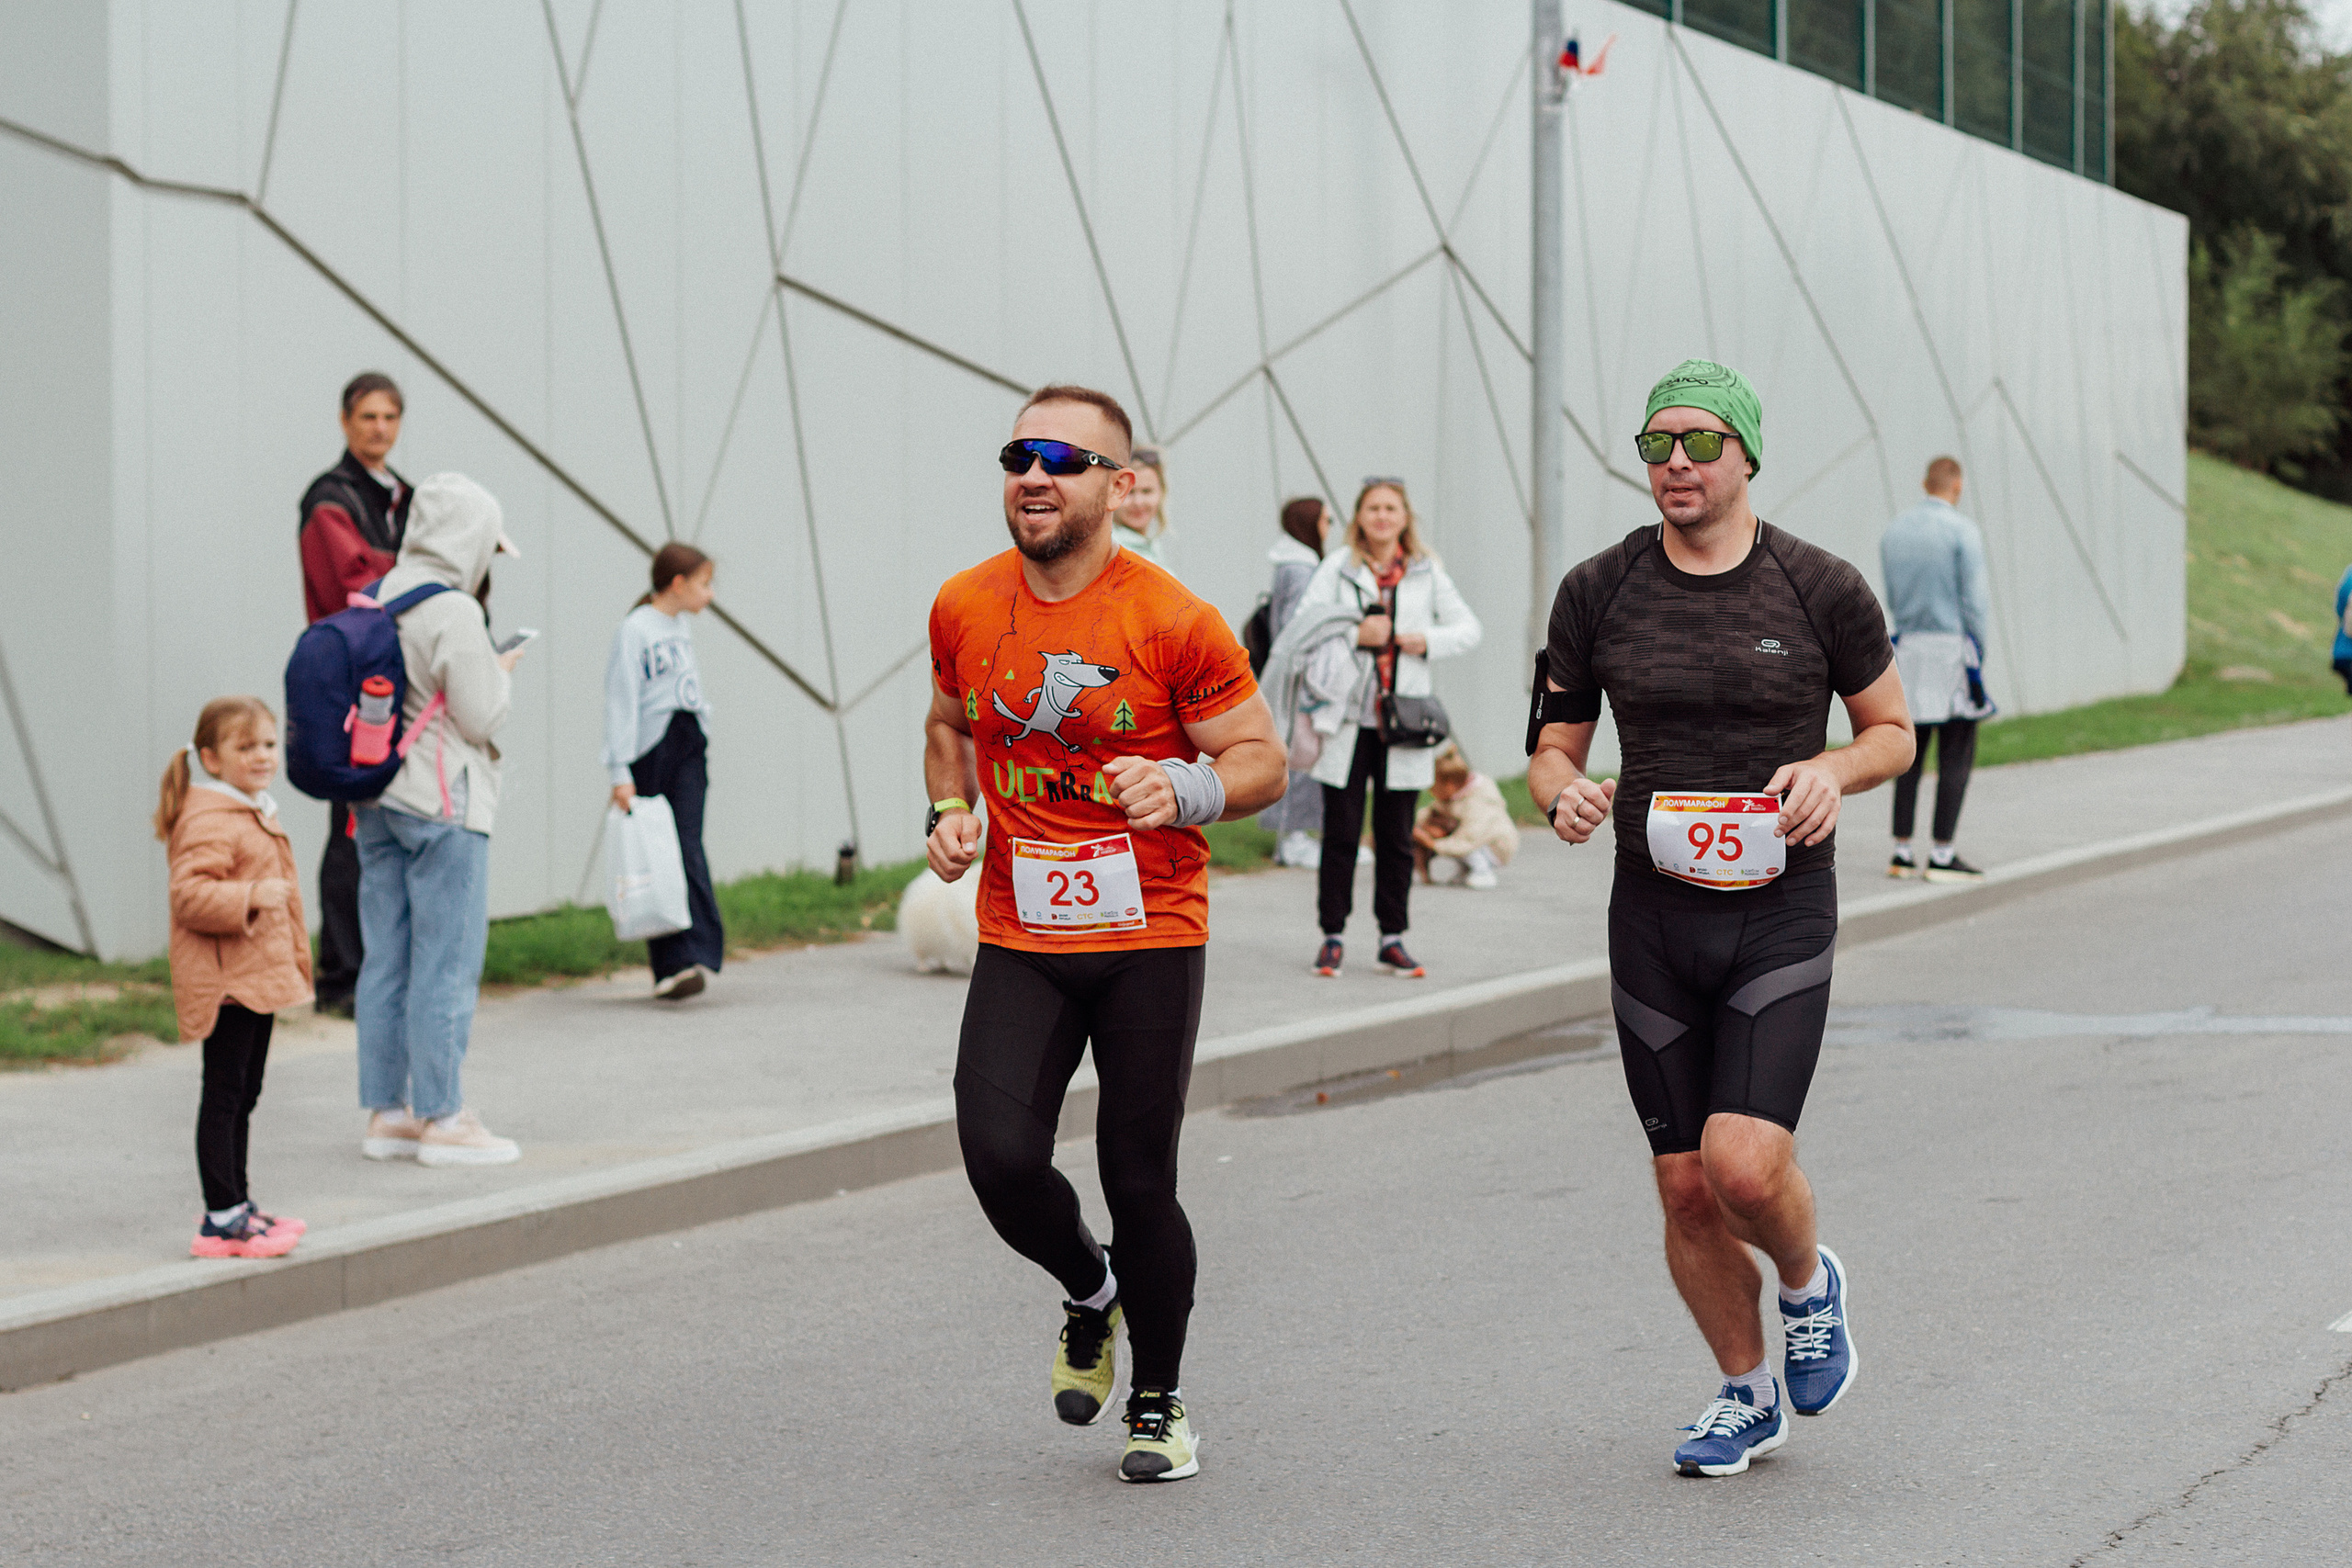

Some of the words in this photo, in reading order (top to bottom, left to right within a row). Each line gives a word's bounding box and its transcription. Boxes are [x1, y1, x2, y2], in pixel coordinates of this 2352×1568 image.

[1755, 646, 1789, 656] Kalenji
[993, 759, 1114, 805] ULTRRRA
[1663, 798, 1725, 809] ПОЛУМАРАФОН
[1020, 845, 1076, 858] ПОЛУМАРАФОН
[1688, 821, 1744, 863] 95
[1046, 869, 1100, 907] 23
